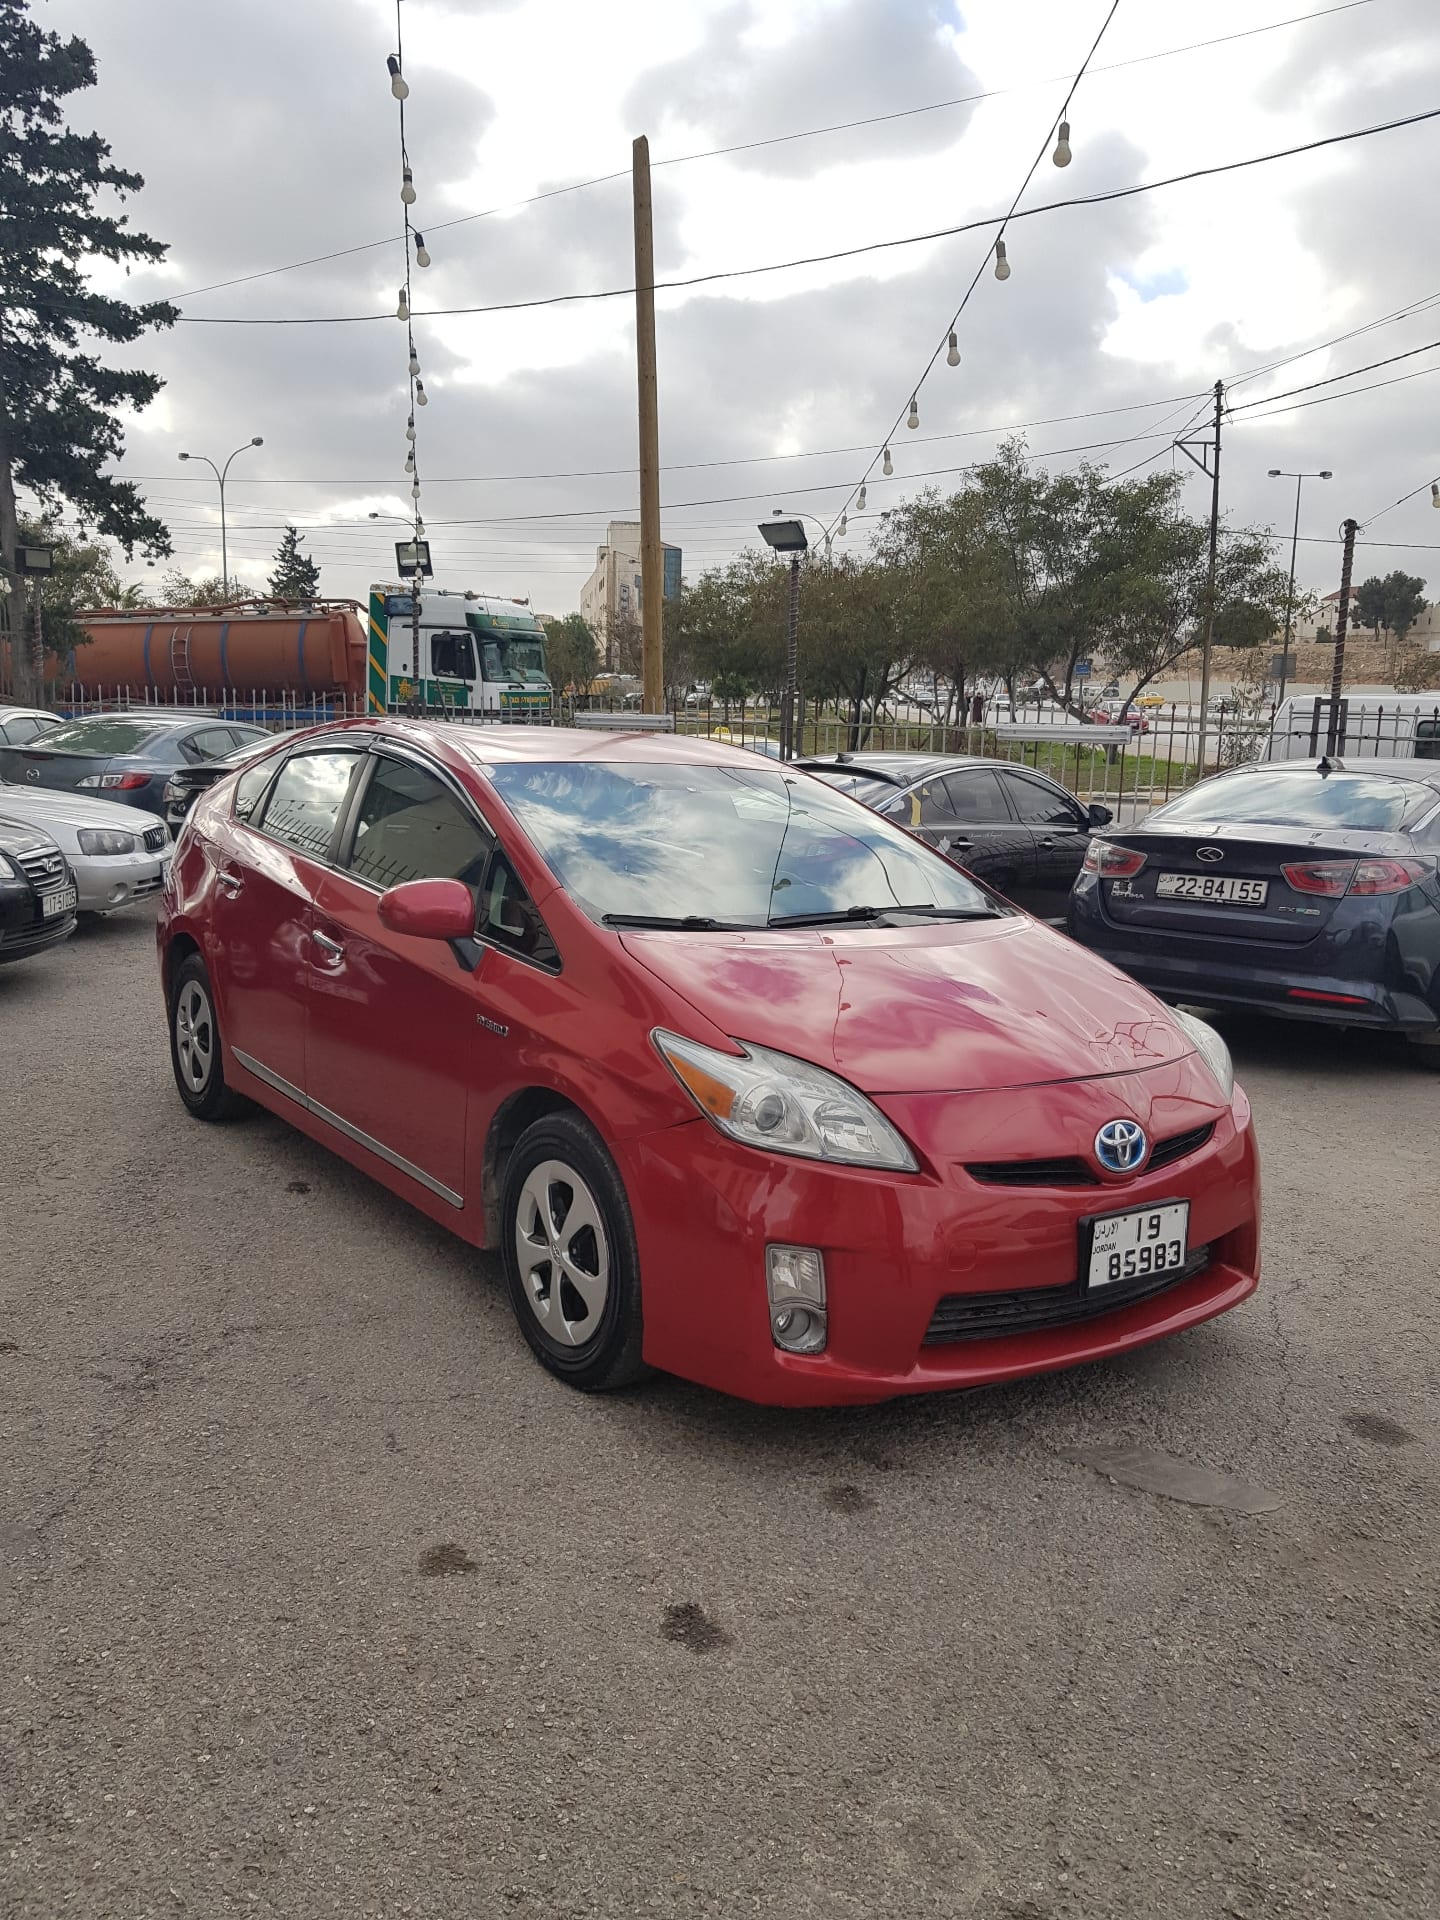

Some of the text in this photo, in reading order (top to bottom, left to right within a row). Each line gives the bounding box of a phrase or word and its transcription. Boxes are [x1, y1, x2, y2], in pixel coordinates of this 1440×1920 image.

[1174, 877, 1263, 900] 22-84155
[1136, 1213, 1161, 1242] 19
[1093, 1242, 1117, 1255] JORDAN
[1108, 1240, 1181, 1280] 85983
